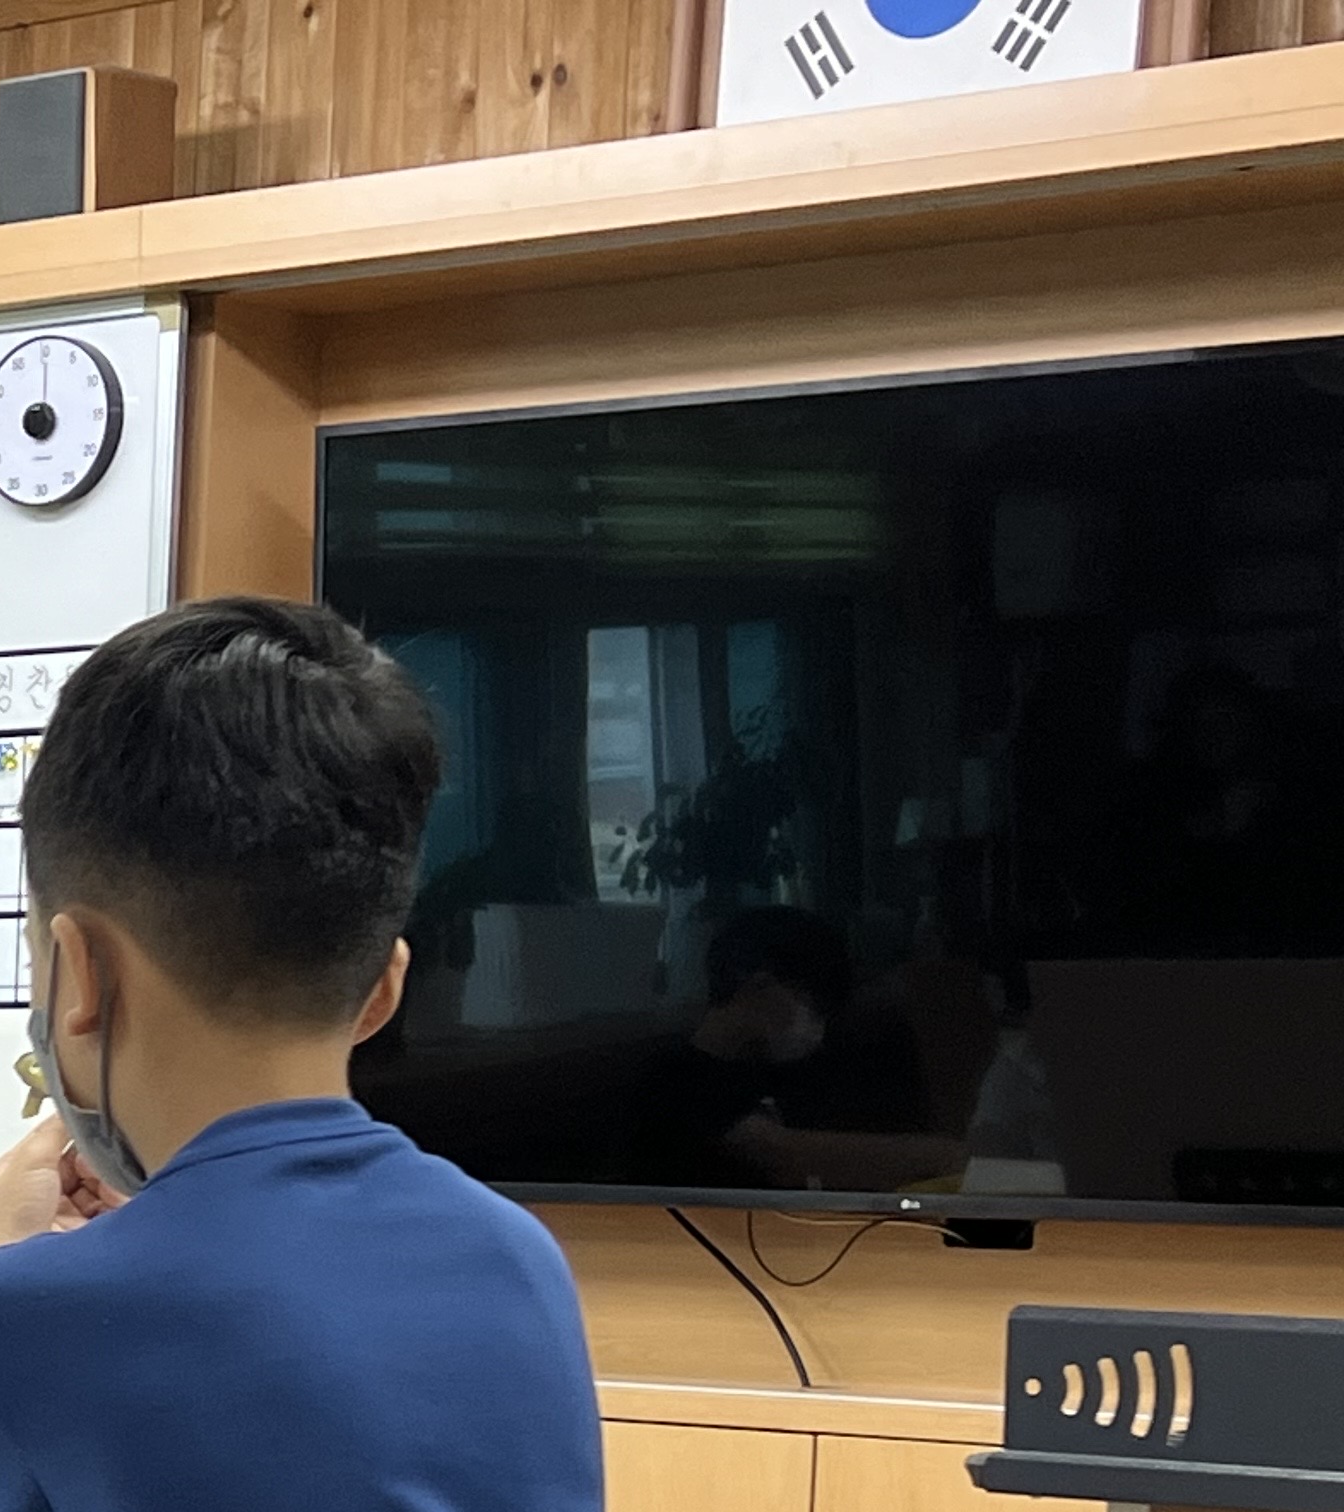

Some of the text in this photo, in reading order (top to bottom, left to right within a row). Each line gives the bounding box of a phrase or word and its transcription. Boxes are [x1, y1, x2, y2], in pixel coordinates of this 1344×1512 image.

[69, 351, 77, 364] 5
[87, 374, 99, 388] 10
[93, 407, 104, 421] 15
[83, 443, 97, 457] 20
[7, 477, 20, 491] 35
[62, 471, 76, 485] 25
[35, 484, 48, 497] 30
